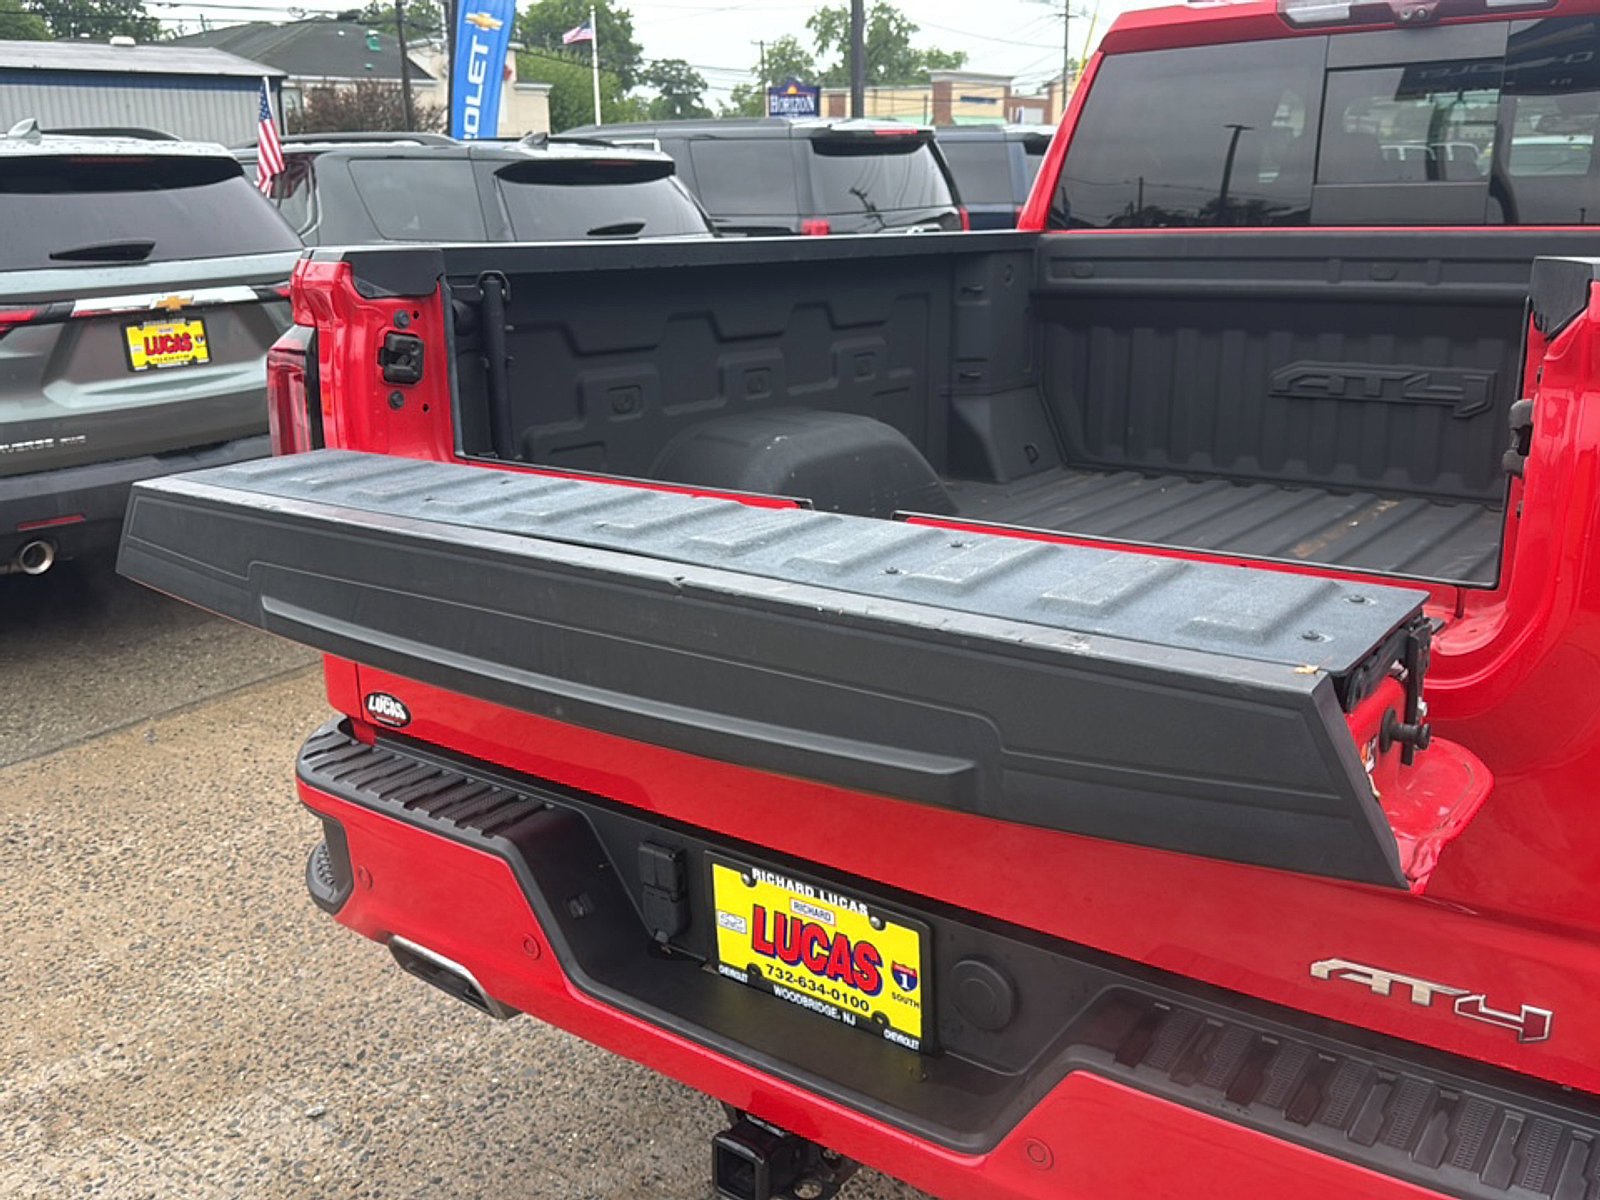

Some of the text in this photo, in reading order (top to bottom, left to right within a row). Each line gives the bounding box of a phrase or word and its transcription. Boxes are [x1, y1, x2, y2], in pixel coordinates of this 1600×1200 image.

[770, 95, 815, 112] HORIZON
[144, 332, 192, 356] LUCAS
[368, 694, 406, 720] LUCAS
[752, 867, 868, 916] RICHARD LUCAS
[793, 901, 831, 920] RICHARD
[752, 903, 883, 997] LUCAS
[766, 963, 870, 1012] 732-634-0100
[899, 973, 910, 990] 1
[891, 992, 920, 1009] SOUTH
[1309, 957, 1552, 1043] AT4
[842, 1011, 856, 1026] NJ
